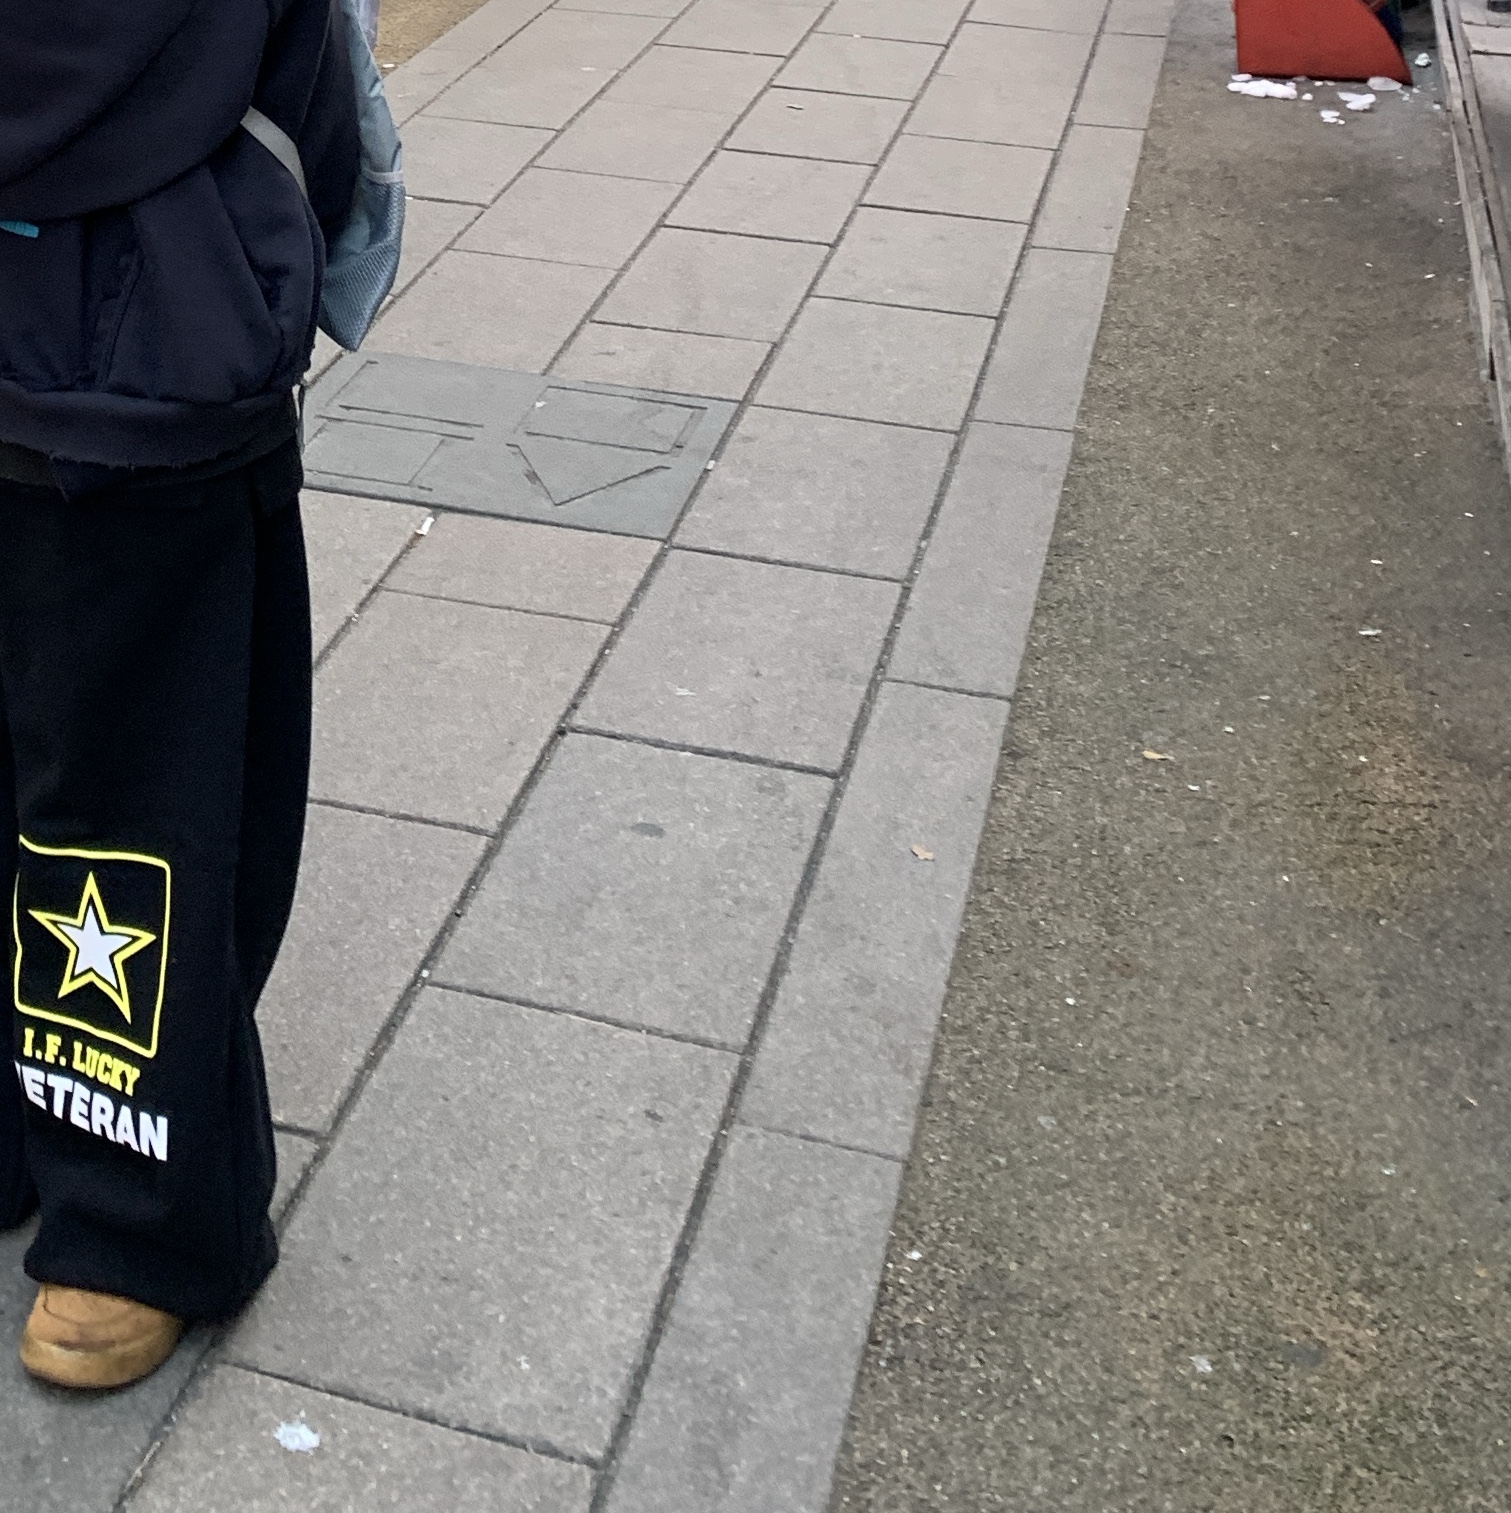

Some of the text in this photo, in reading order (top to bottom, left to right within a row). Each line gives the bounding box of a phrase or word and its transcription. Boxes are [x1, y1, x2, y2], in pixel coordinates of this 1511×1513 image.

[23, 1027, 141, 1098] I.F. LUCKY
[14, 1058, 169, 1162] ETERAN
